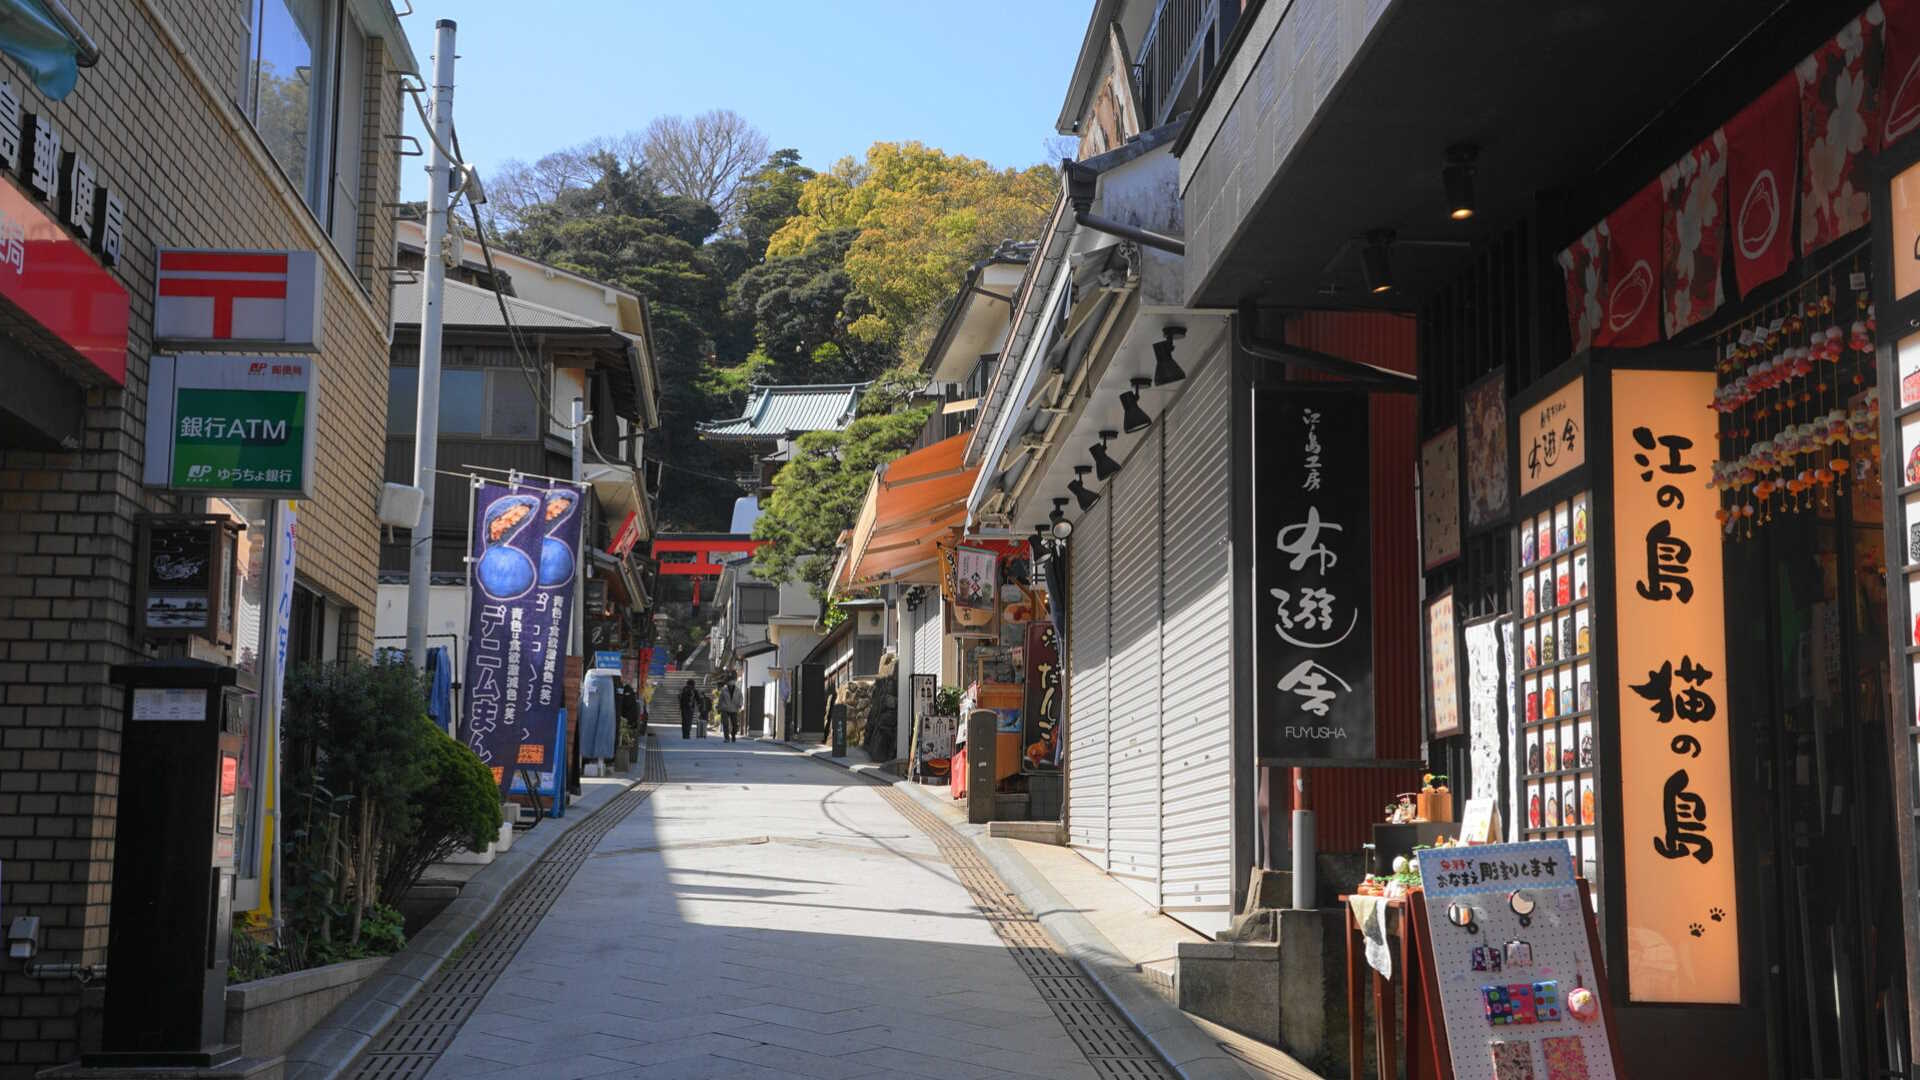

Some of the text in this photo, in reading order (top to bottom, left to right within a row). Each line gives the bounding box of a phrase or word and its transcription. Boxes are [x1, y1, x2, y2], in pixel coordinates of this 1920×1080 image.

[180, 415, 286, 440] 銀行ATM
[217, 468, 292, 482] ゆうちょ銀行
[1628, 426, 1716, 864] 江の島 猫の島
[469, 604, 507, 764] デニムまん
[1285, 726, 1347, 740] FUYUSHA
[1436, 871, 1480, 889] おなまえ
